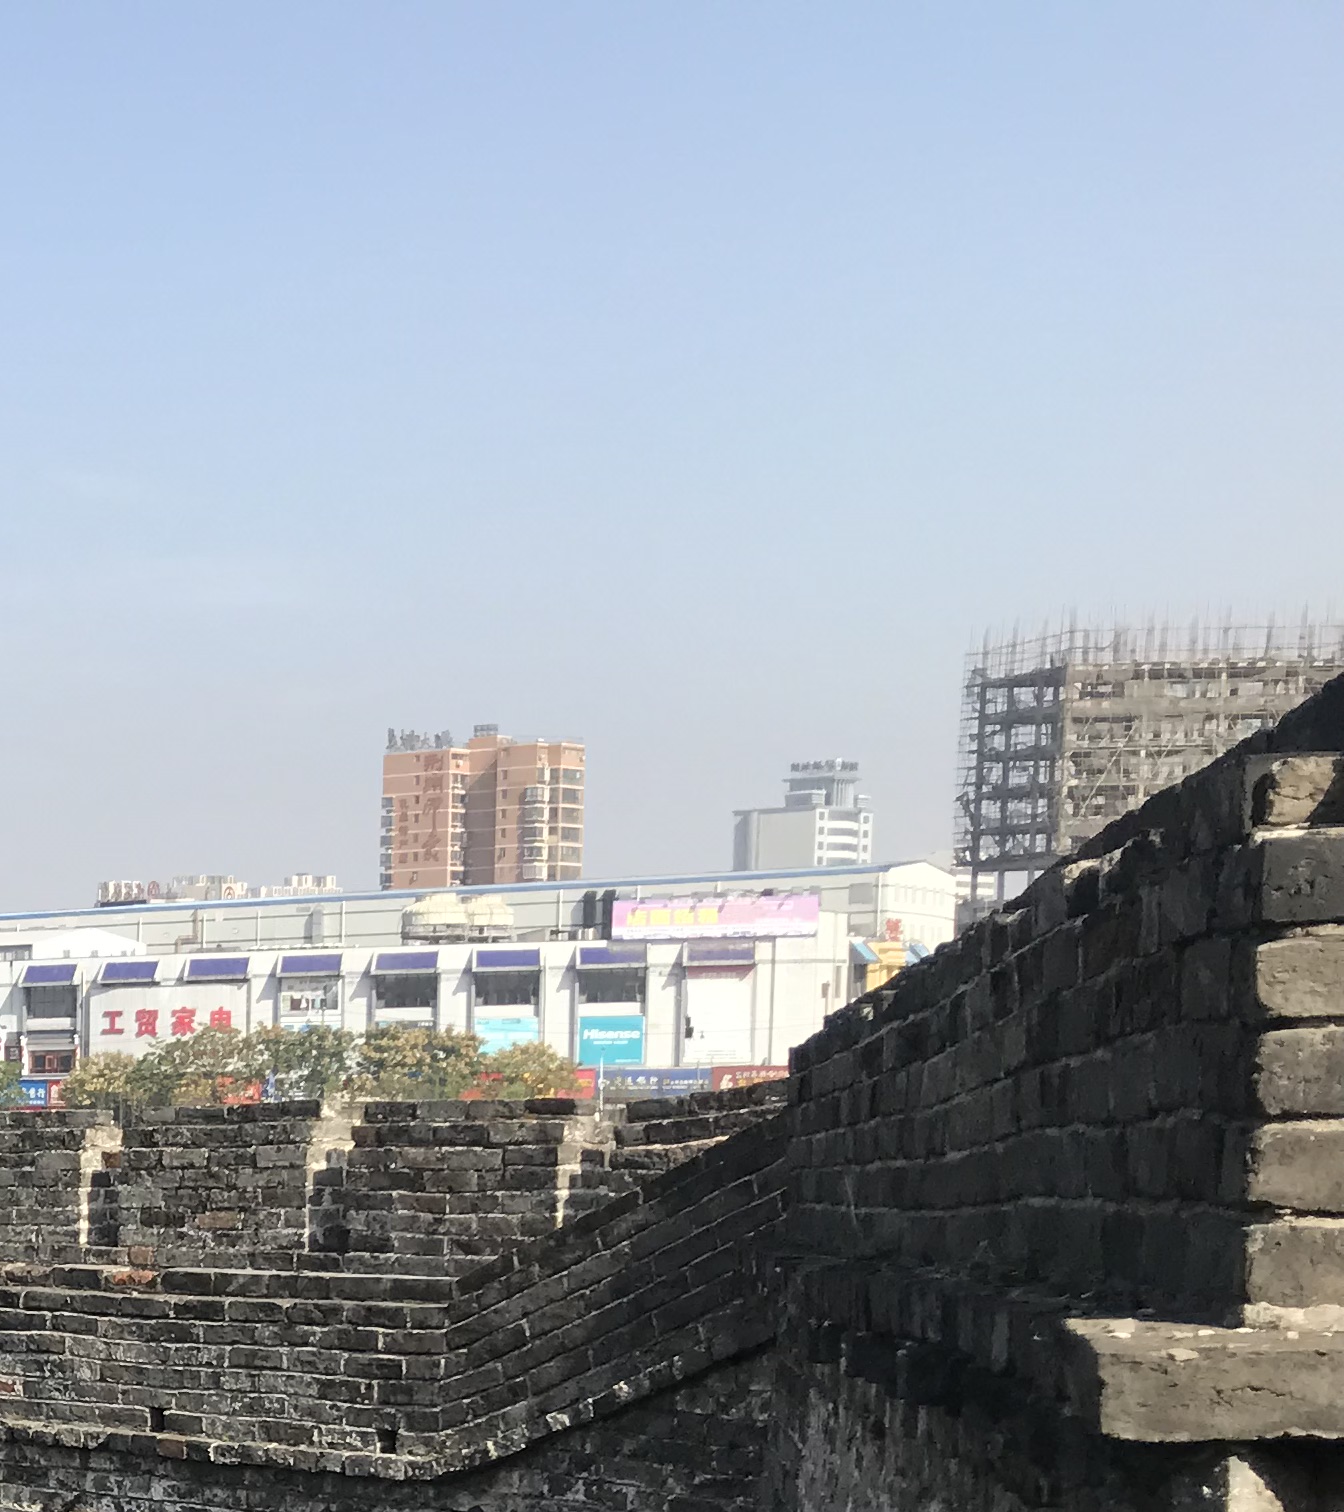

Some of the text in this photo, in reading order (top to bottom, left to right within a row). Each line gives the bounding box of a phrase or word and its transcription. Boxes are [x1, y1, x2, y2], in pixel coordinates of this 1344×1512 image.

[100, 1006, 232, 1038] 工贸家电
[583, 1029, 641, 1040] Hisense
